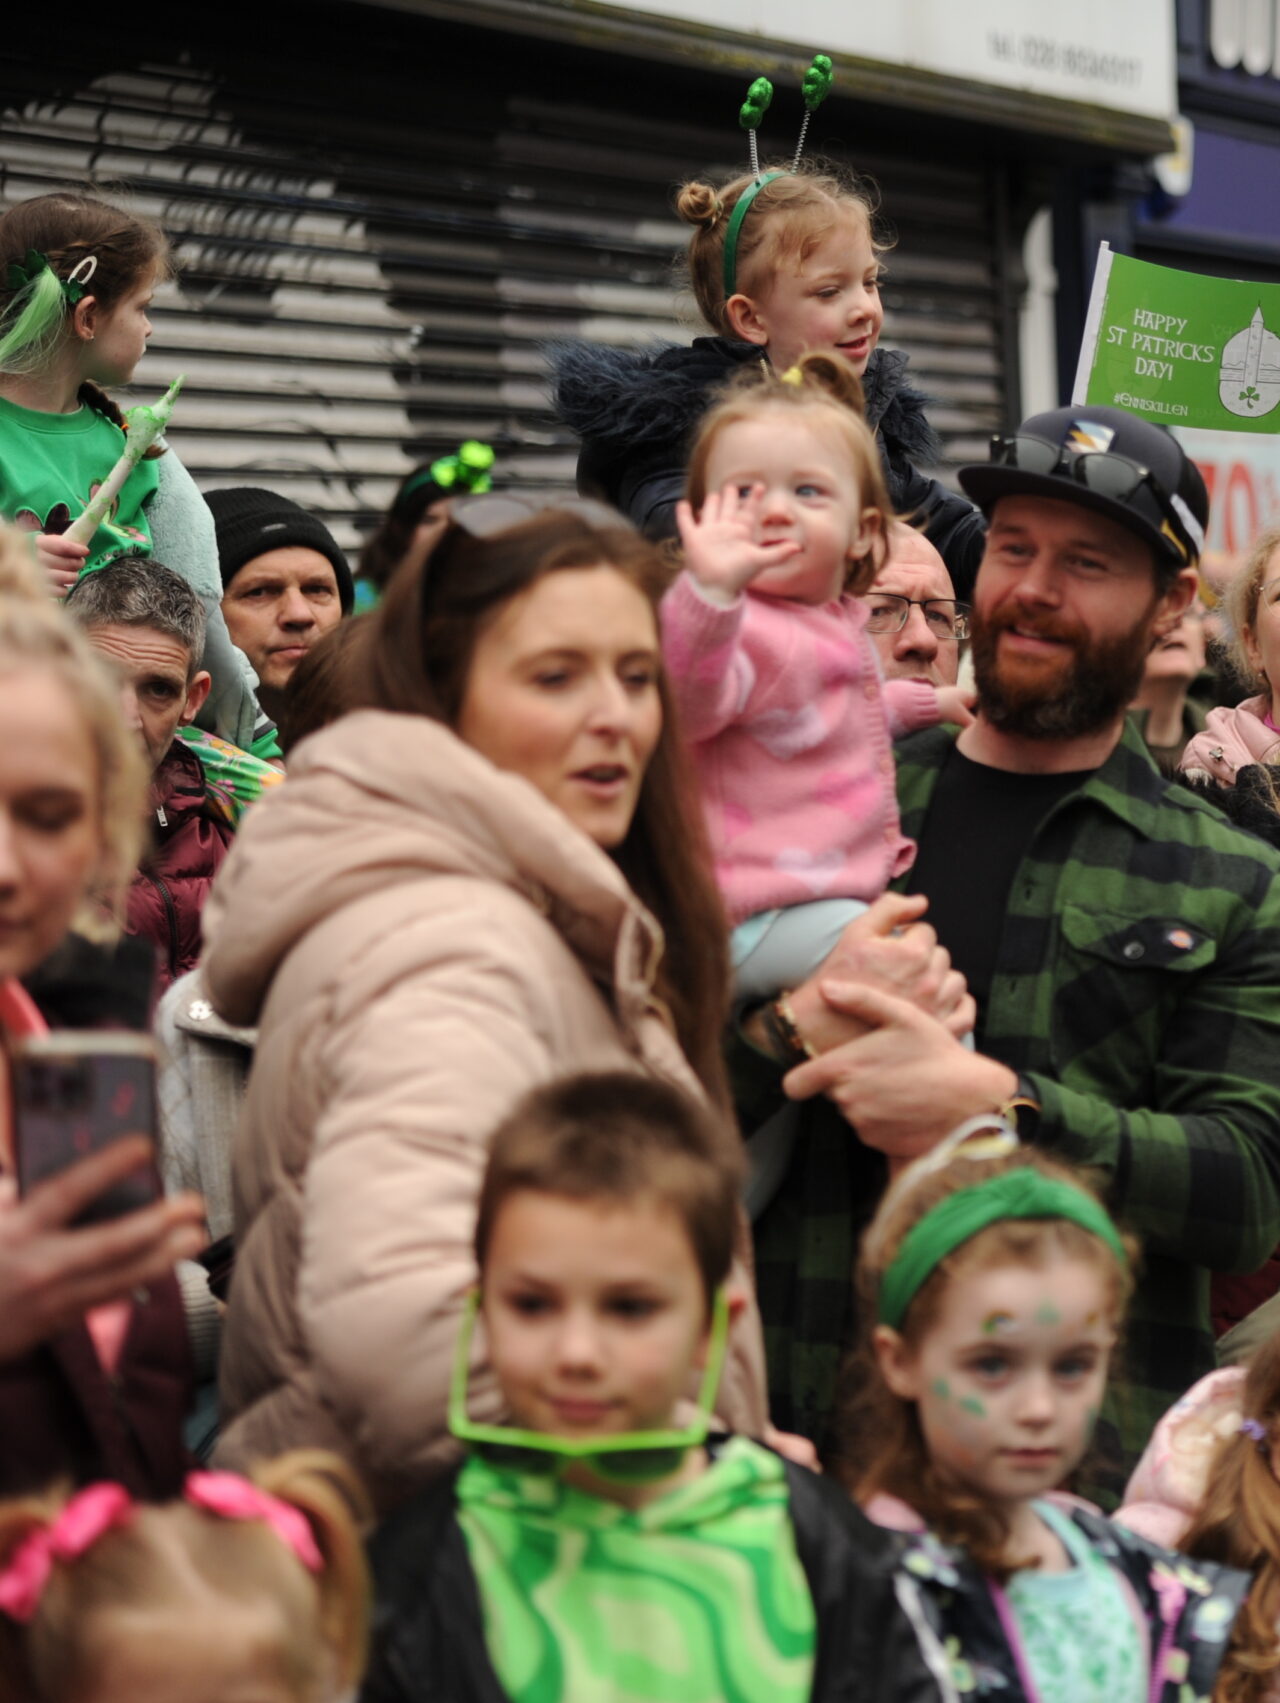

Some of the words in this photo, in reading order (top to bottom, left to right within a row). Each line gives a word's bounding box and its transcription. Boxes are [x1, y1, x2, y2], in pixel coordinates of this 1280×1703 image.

[1133, 308, 1188, 335] HAPPY
[1106, 325, 1127, 344] ST
[1131, 331, 1215, 363] PATRICKS
[1135, 356, 1174, 381] DAY!
